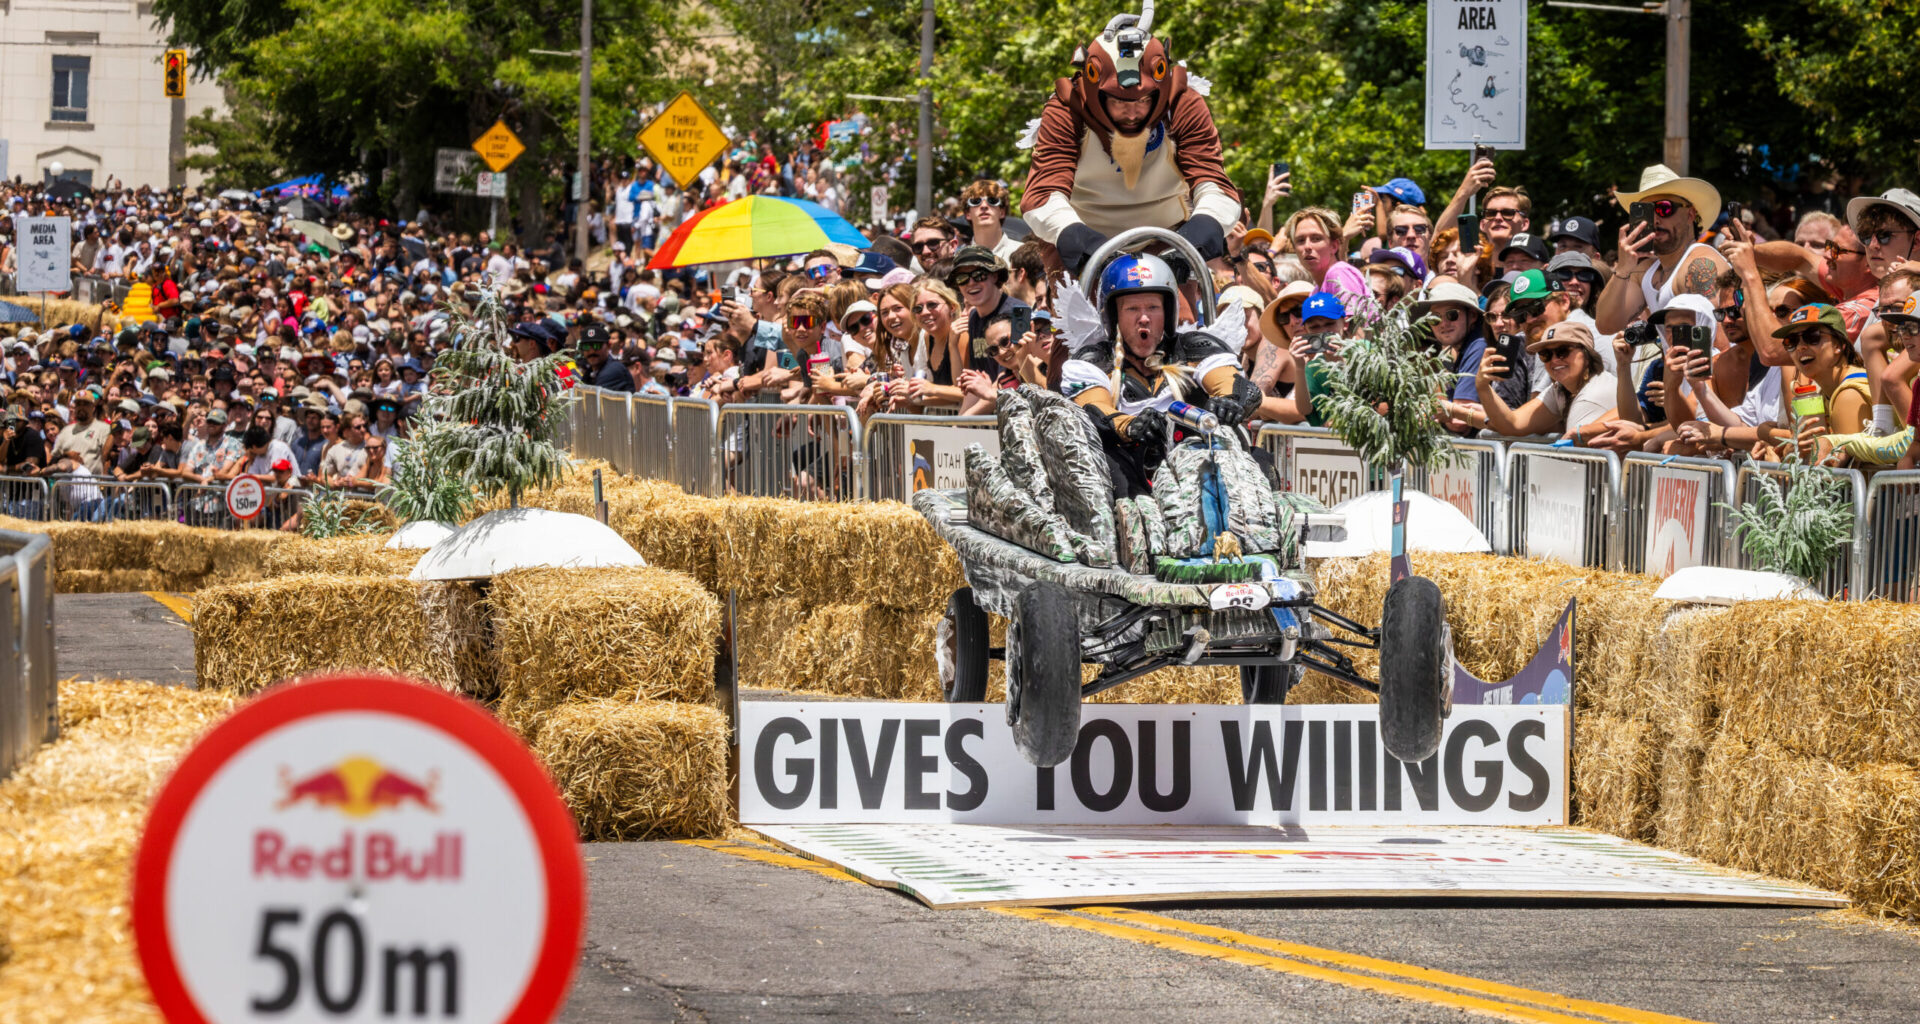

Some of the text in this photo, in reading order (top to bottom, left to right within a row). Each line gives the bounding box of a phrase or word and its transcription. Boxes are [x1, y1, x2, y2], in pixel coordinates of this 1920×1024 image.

[1458, 7, 1496, 29] AREA
[672, 115, 698, 126] THRU
[665, 128, 704, 140] TRAFFIC
[667, 142, 700, 153] MERGE
[671, 156, 695, 168] LEFT
[30, 224, 56, 234] MEDIA
[33, 235, 55, 245] AREA
[938, 453, 960, 469] UTAH
[1653, 477, 1700, 560] MAVERIK
[754, 716, 989, 812] GIVES
[1220, 718, 1550, 812] WIIINGS
[252, 829, 464, 882] Red Bull
[249, 903, 460, 1018] 50m
